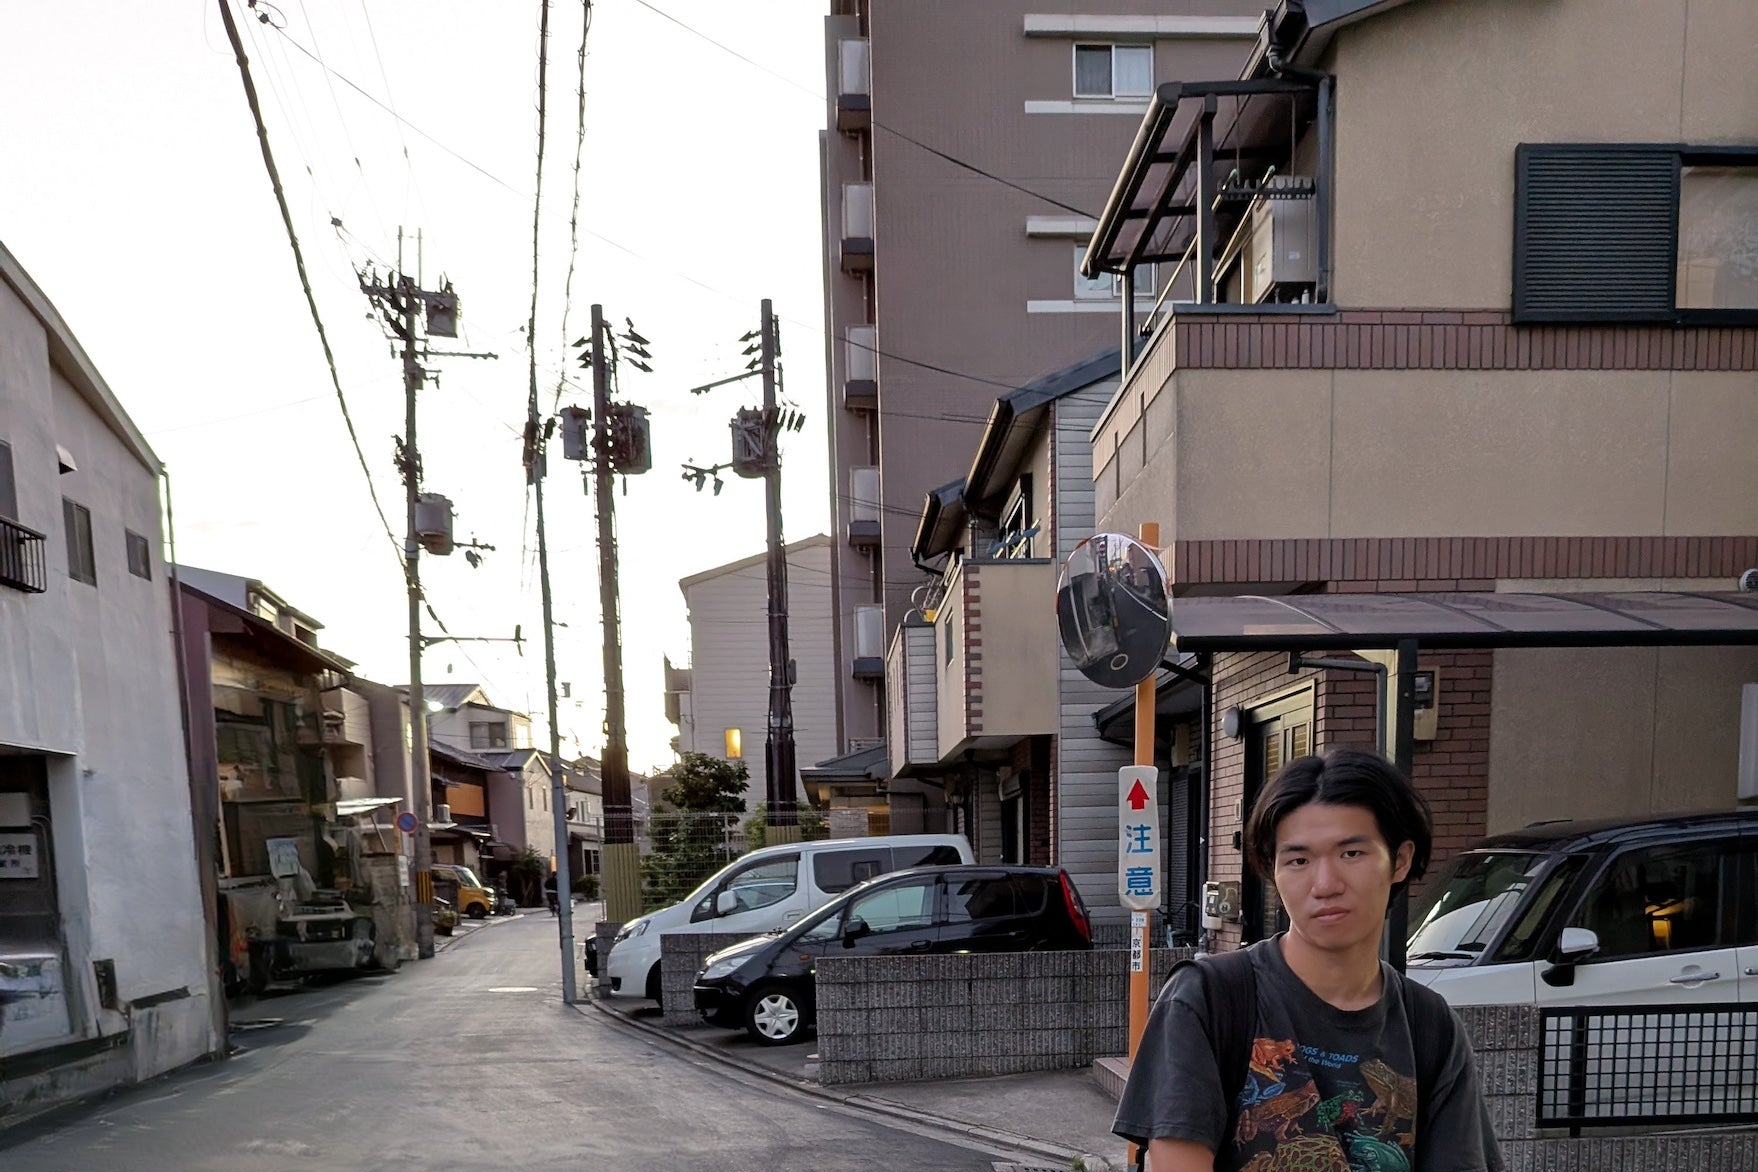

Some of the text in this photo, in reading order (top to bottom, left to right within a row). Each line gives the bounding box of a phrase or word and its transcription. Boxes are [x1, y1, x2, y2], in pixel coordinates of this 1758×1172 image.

[1125, 823, 1154, 896] 注意
[1132, 938, 1142, 971] 京都市
[1308, 1056, 1320, 1064] the
[1321, 1059, 1342, 1070] World
[1328, 1052, 1359, 1063] TOADS
